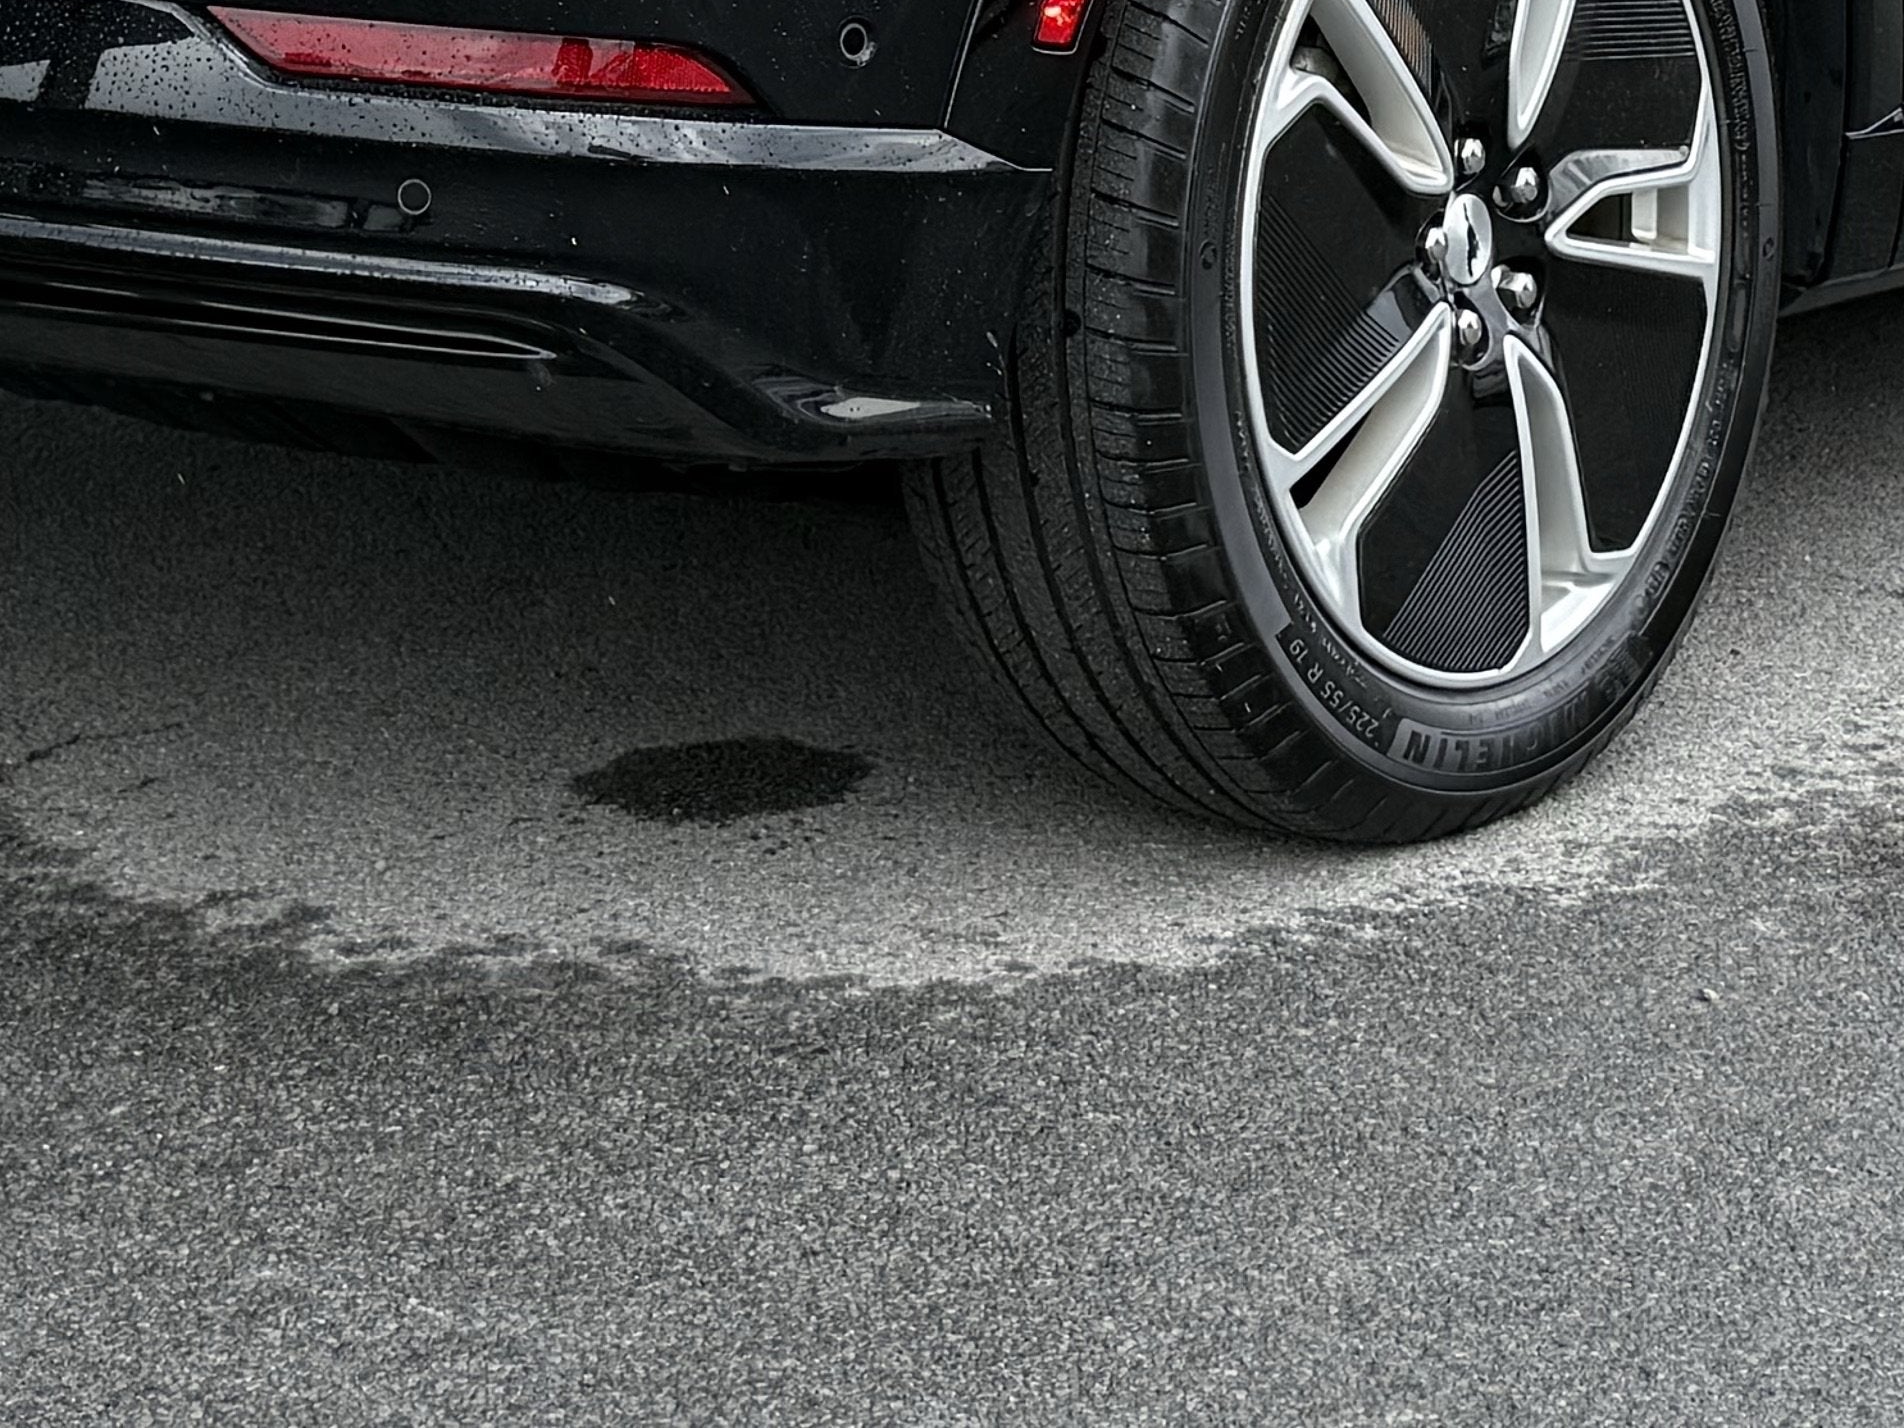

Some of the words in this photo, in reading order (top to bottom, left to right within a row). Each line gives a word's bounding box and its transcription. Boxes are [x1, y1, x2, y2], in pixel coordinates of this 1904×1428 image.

[1288, 638, 1309, 661] 19
[1307, 661, 1325, 680] R
[1320, 684, 1380, 740] 225/55
